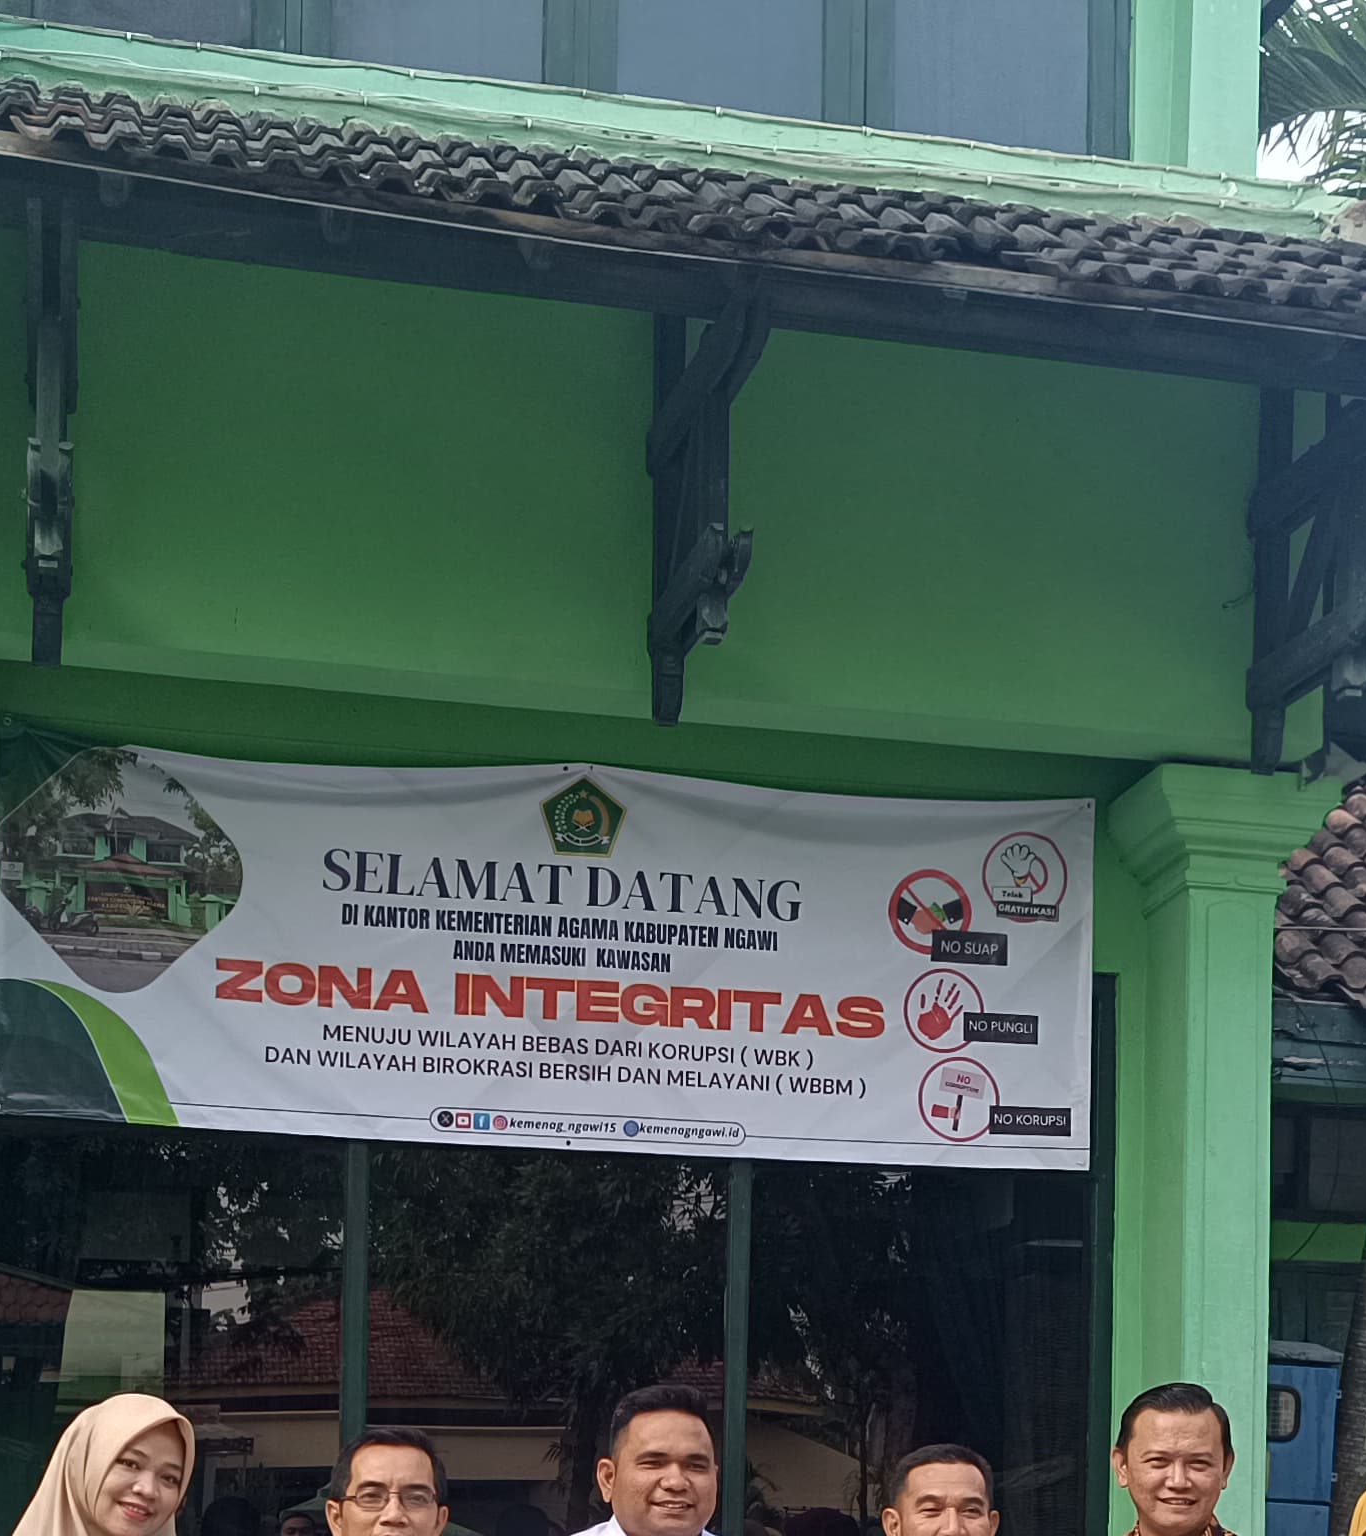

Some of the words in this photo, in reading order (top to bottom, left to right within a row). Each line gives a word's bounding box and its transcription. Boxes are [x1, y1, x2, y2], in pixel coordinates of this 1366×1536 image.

[322, 848, 573, 905] SELAMAT
[586, 865, 803, 922] DATANG
[998, 903, 1055, 917] GRATIFIKASI
[341, 903, 359, 926] DI
[363, 905, 431, 931] KANTOR
[435, 909, 552, 938] KEMENTERIAN
[557, 916, 619, 942] AGAMA
[624, 920, 719, 948] KABUPATEN
[723, 926, 779, 952] NGAWI
[452, 939, 495, 963] ANDA
[500, 943, 586, 968] MEMASUKI
[596, 948, 671, 973] KAWASAN
[940, 940, 961, 954] NO
[964, 942, 999, 956] SUAP
[215, 957, 430, 1015] ZONA
[454, 972, 886, 1039] INTEGRITAS
[968, 1020, 988, 1032] NO
[991, 1021, 1033, 1034] PUNGLI
[322, 1024, 412, 1046] MENUJU
[418, 1029, 516, 1051] WILAYAH
[522, 1035, 588, 1055] BEBAS
[595, 1038, 643, 1058] DARI
[648, 1042, 735, 1064] KORUPSI
[753, 1048, 800, 1068] WBK
[264, 1046, 311, 1066] DAN
[318, 1051, 417, 1073] WILAYAH
[422, 1056, 533, 1078] BIROKRASI
[539, 1062, 611, 1083] BERSIH
[618, 1066, 661, 1085] DAN
[667, 1070, 770, 1092] MELAYANI
[789, 1075, 853, 1096] WBBM
[956, 1074, 971, 1084] NO
[639, 1123, 739, 1140] kemenagngawi.id
[994, 1113, 1013, 1125] NO
[1016, 1114, 1066, 1127] KORUPSI
